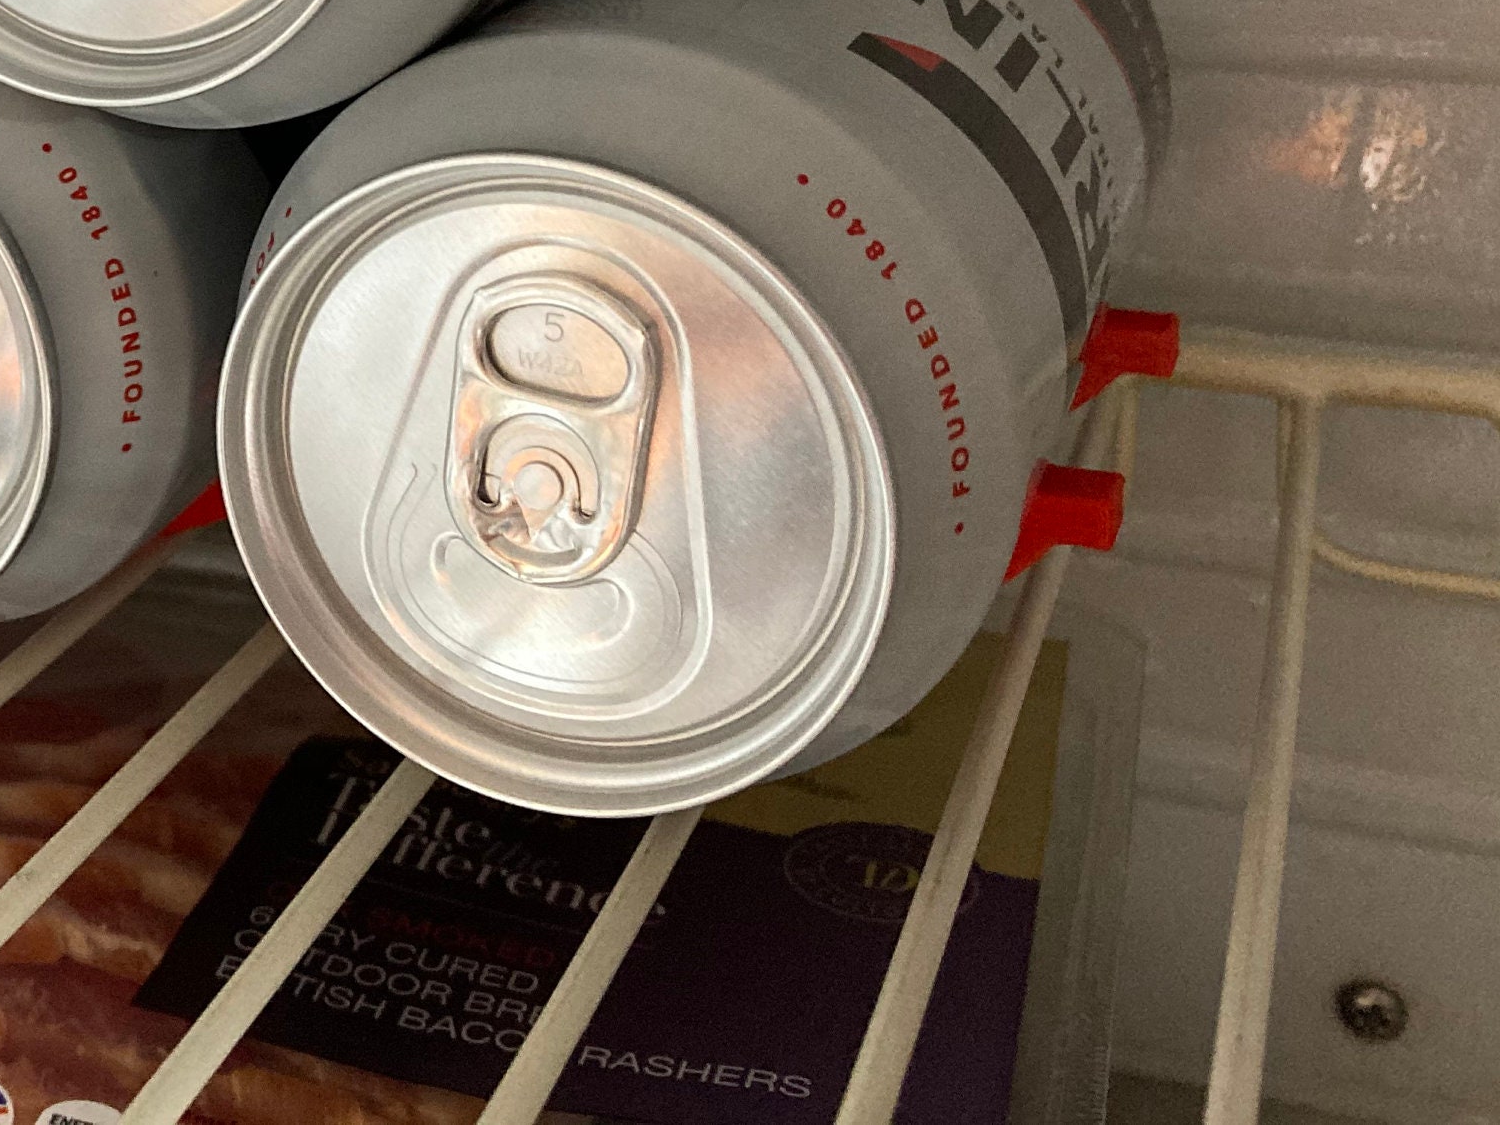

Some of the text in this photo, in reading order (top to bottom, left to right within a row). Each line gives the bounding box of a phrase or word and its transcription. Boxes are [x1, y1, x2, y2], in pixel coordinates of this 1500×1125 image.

[58, 166, 144, 424] FOUNDED 1840
[544, 312, 565, 342] 5
[826, 198, 970, 499] FOUNDED 1840
[328, 773, 491, 847] Tste
[317, 811, 667, 921] fferenc
[233, 928, 451, 1006] OTDOOR
[250, 905, 274, 925] 6
[386, 942, 539, 993] CURED
[215, 955, 813, 1098] BTISH BACO RASHERS
